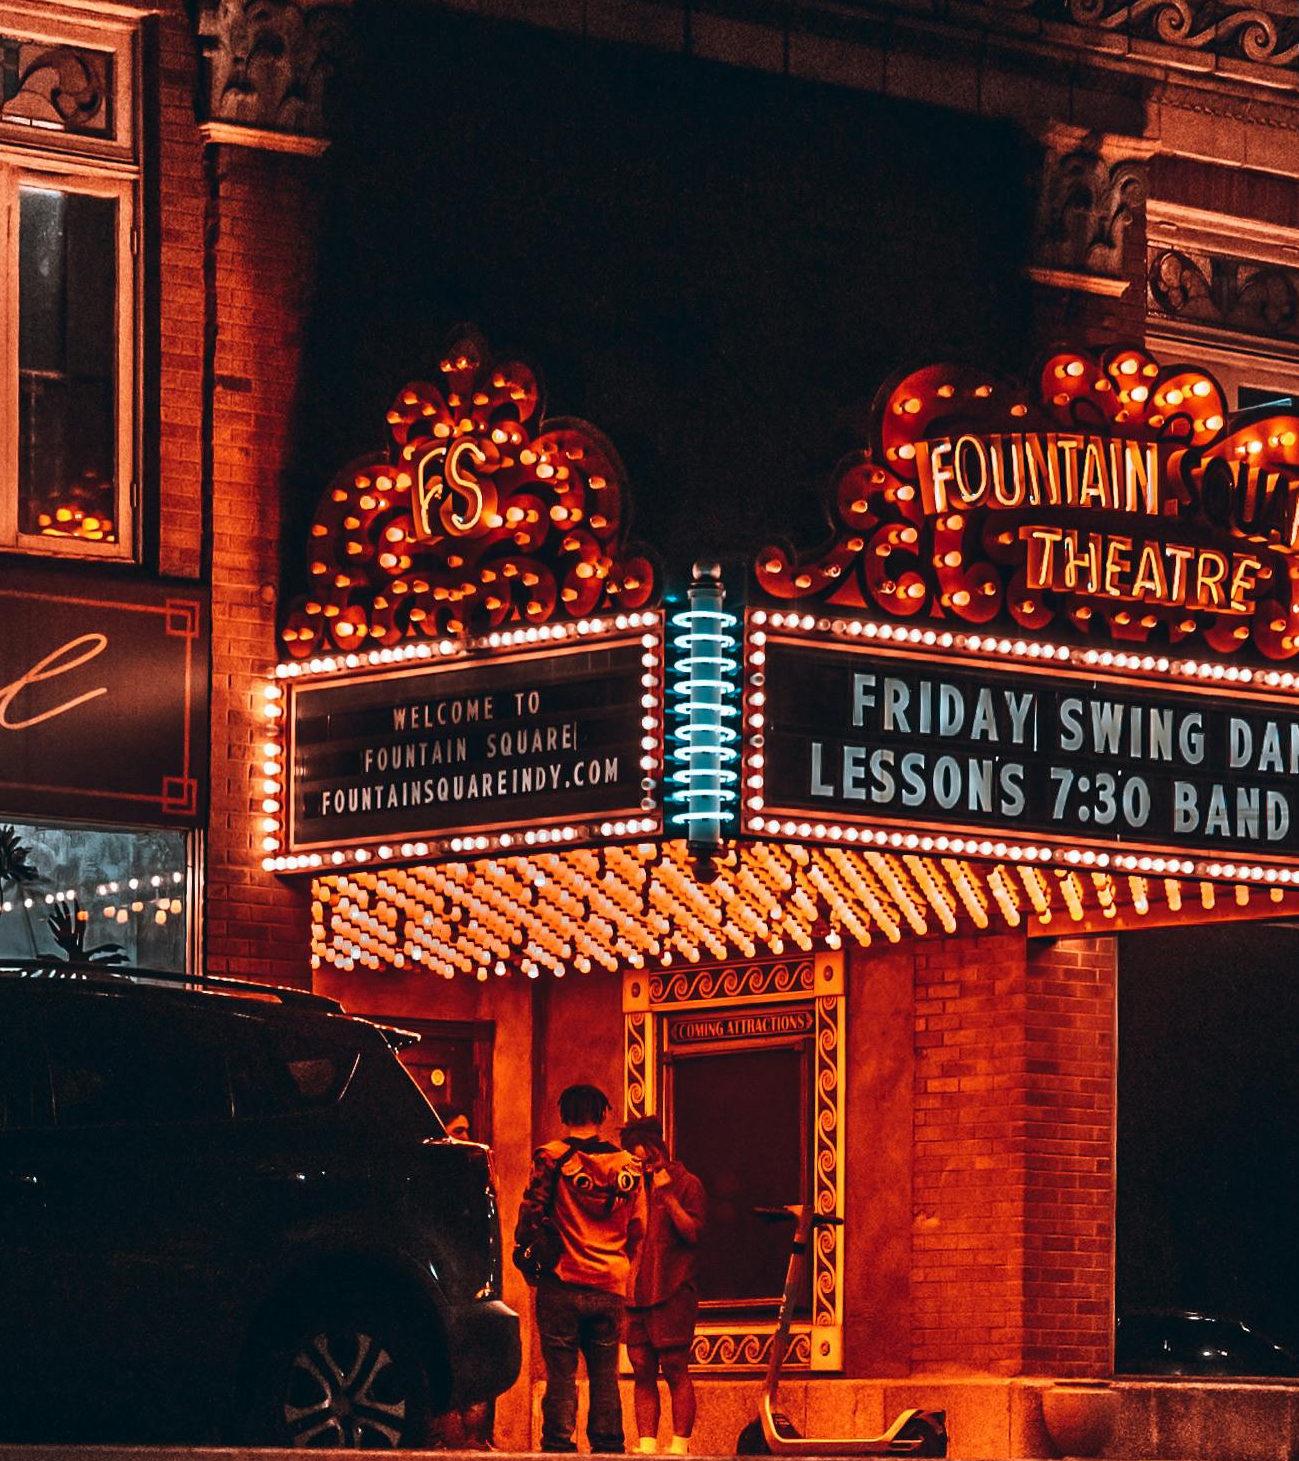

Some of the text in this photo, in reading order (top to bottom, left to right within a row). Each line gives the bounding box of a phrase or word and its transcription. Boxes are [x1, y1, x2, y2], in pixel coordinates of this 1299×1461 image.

[410, 437, 499, 544] FS
[915, 432, 1160, 516] FOUNTAIN
[1019, 525, 1261, 615] THEATRE
[364, 723, 572, 774] FOUNTAIN SQUARE
[393, 690, 541, 731] WELCOME TO
[852, 673, 1034, 745] FRIDAY
[1060, 698, 1205, 766] SWING
[322, 757, 619, 816] FOUNTAINSQUAREINDY.COM
[810, 742, 1026, 818] LESSONS
[1051, 766, 1151, 828] 7:30
[1174, 780, 1290, 841] BAND
[679, 1012, 805, 1039] COMING ATTRACTIONS
